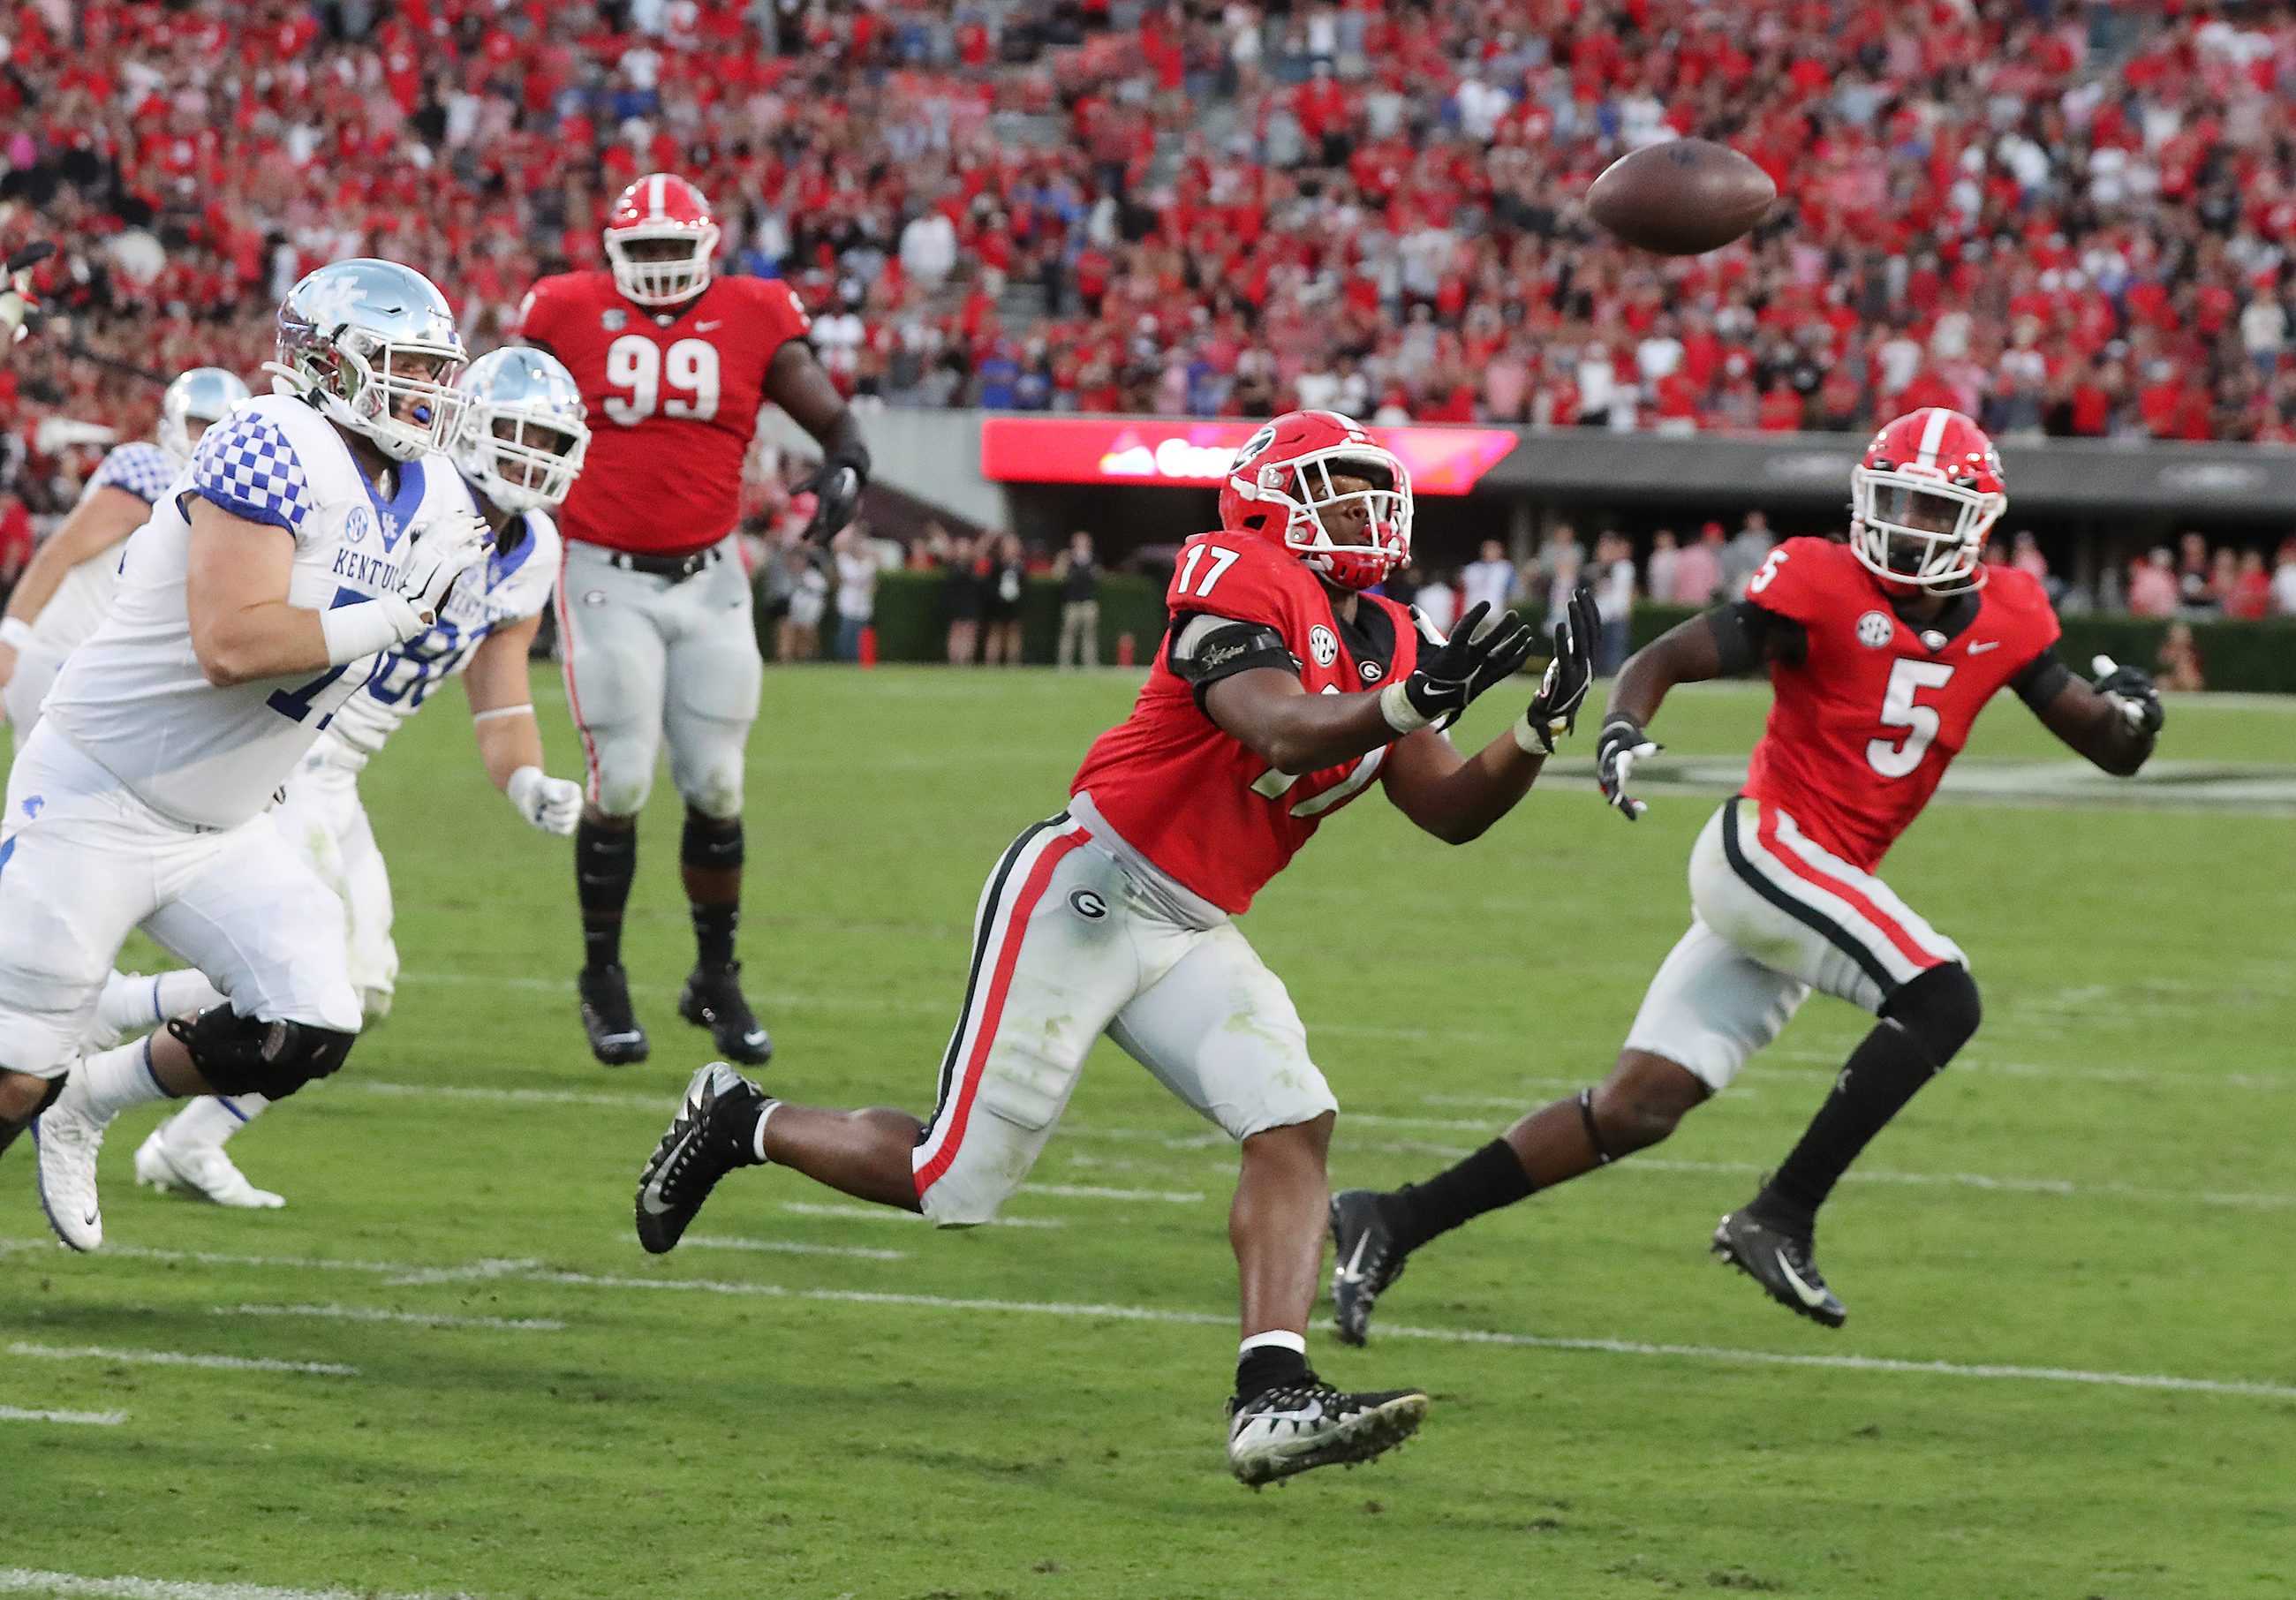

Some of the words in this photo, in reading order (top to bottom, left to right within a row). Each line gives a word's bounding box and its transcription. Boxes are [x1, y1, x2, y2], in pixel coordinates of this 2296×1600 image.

[603, 335, 721, 426] 99
[1177, 543, 1241, 598] 17
[1750, 549, 1789, 592] 5
[1866, 657, 1956, 778] 5
